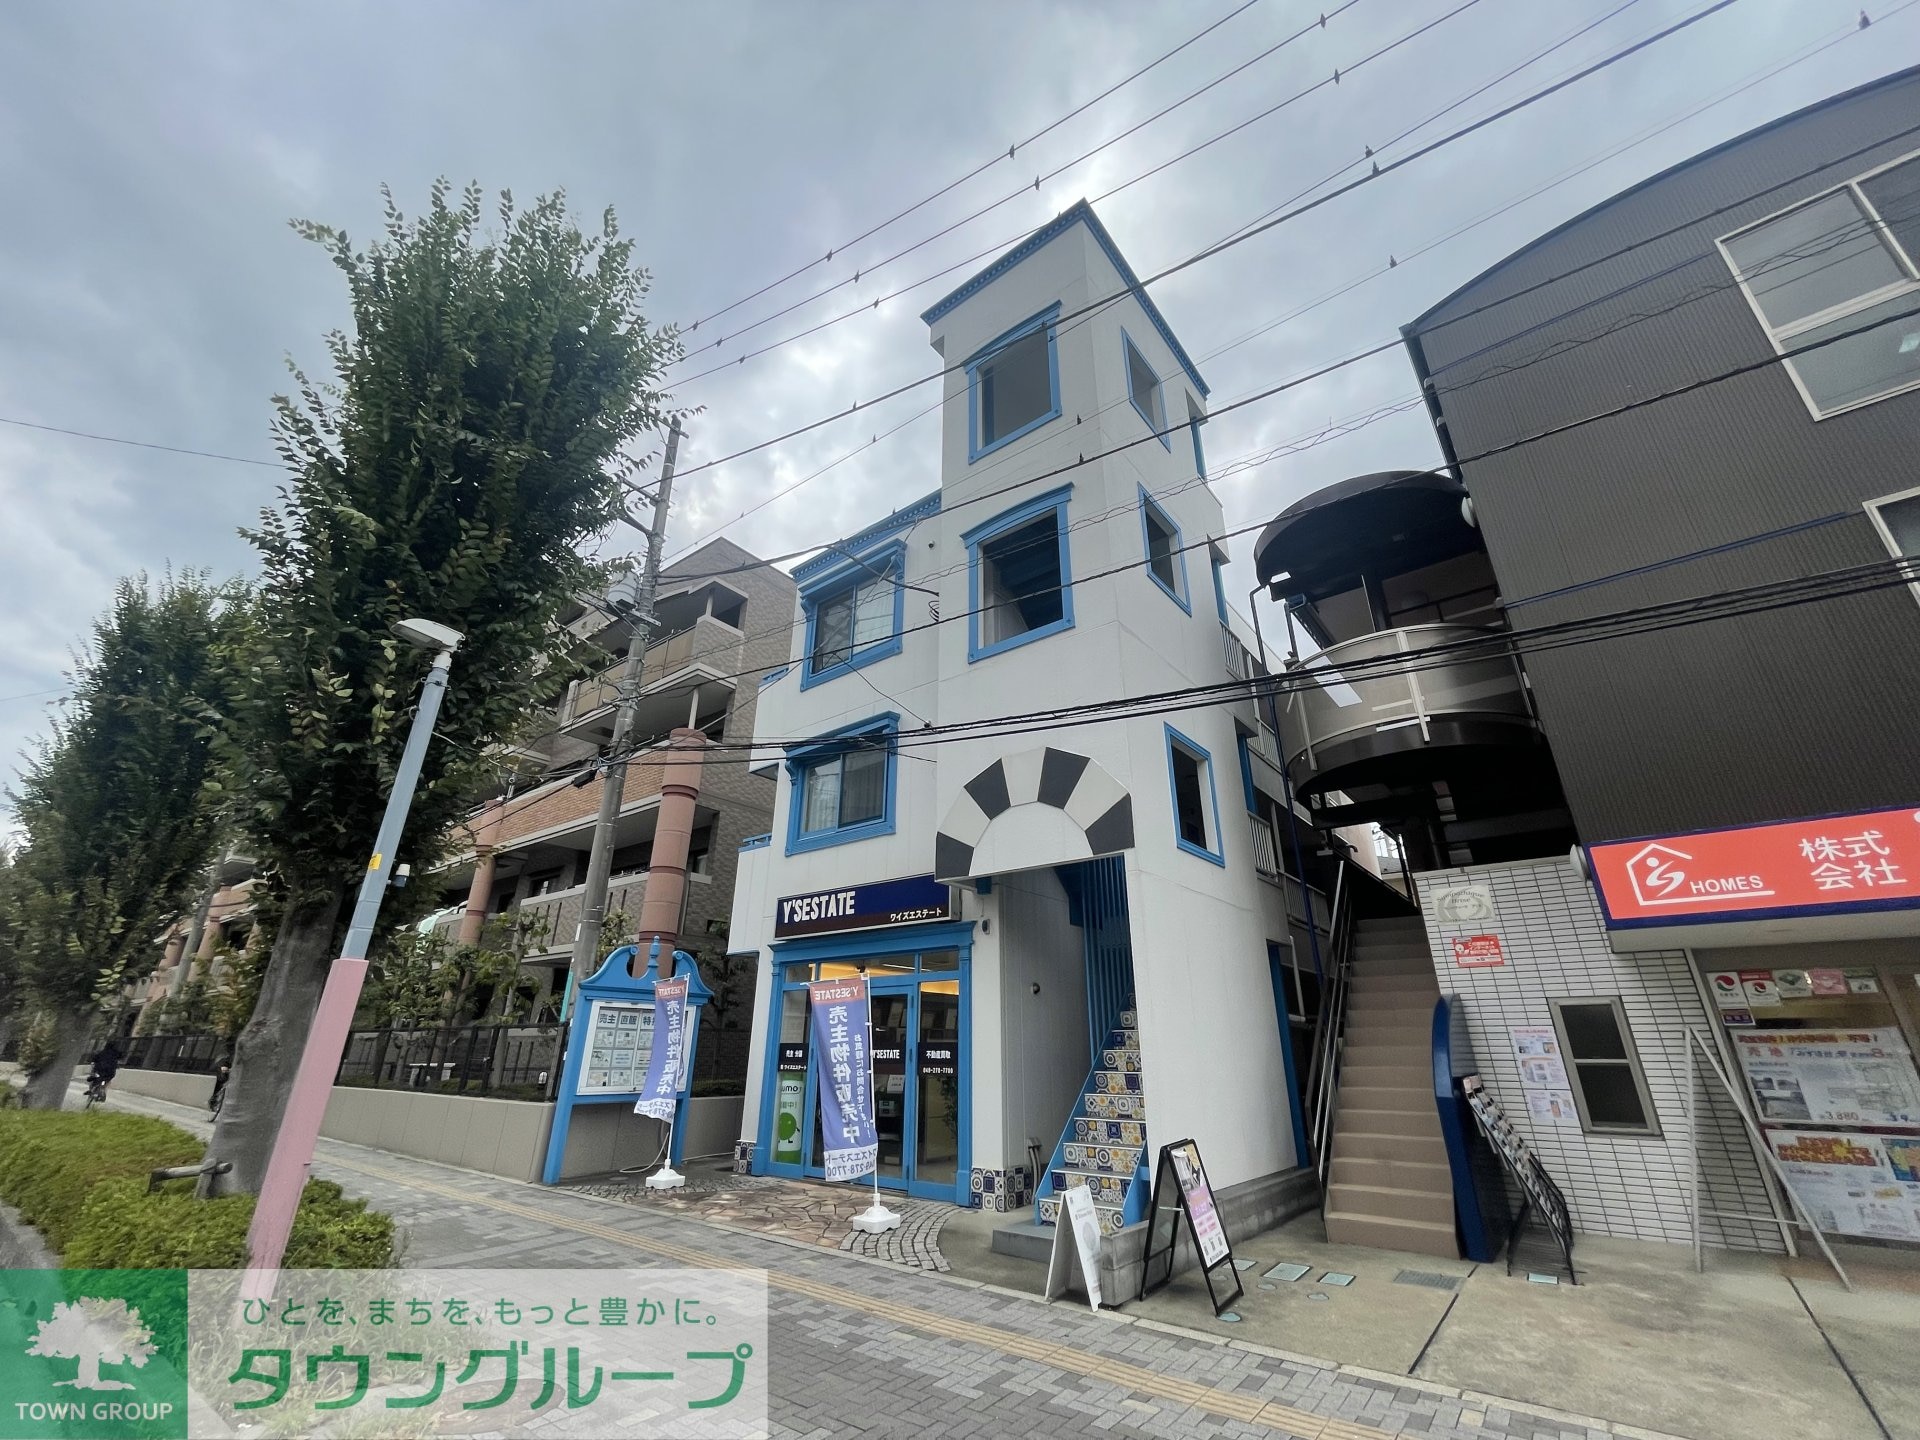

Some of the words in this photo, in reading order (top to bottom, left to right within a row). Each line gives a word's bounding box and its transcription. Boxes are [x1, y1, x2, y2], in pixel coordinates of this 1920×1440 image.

[1798, 829, 1891, 863] 株式
[1690, 874, 1764, 895] HOMES
[1810, 858, 1908, 890] 会社
[783, 890, 856, 924] Y'SESTATE
[890, 907, 942, 922] ワイズエステート
